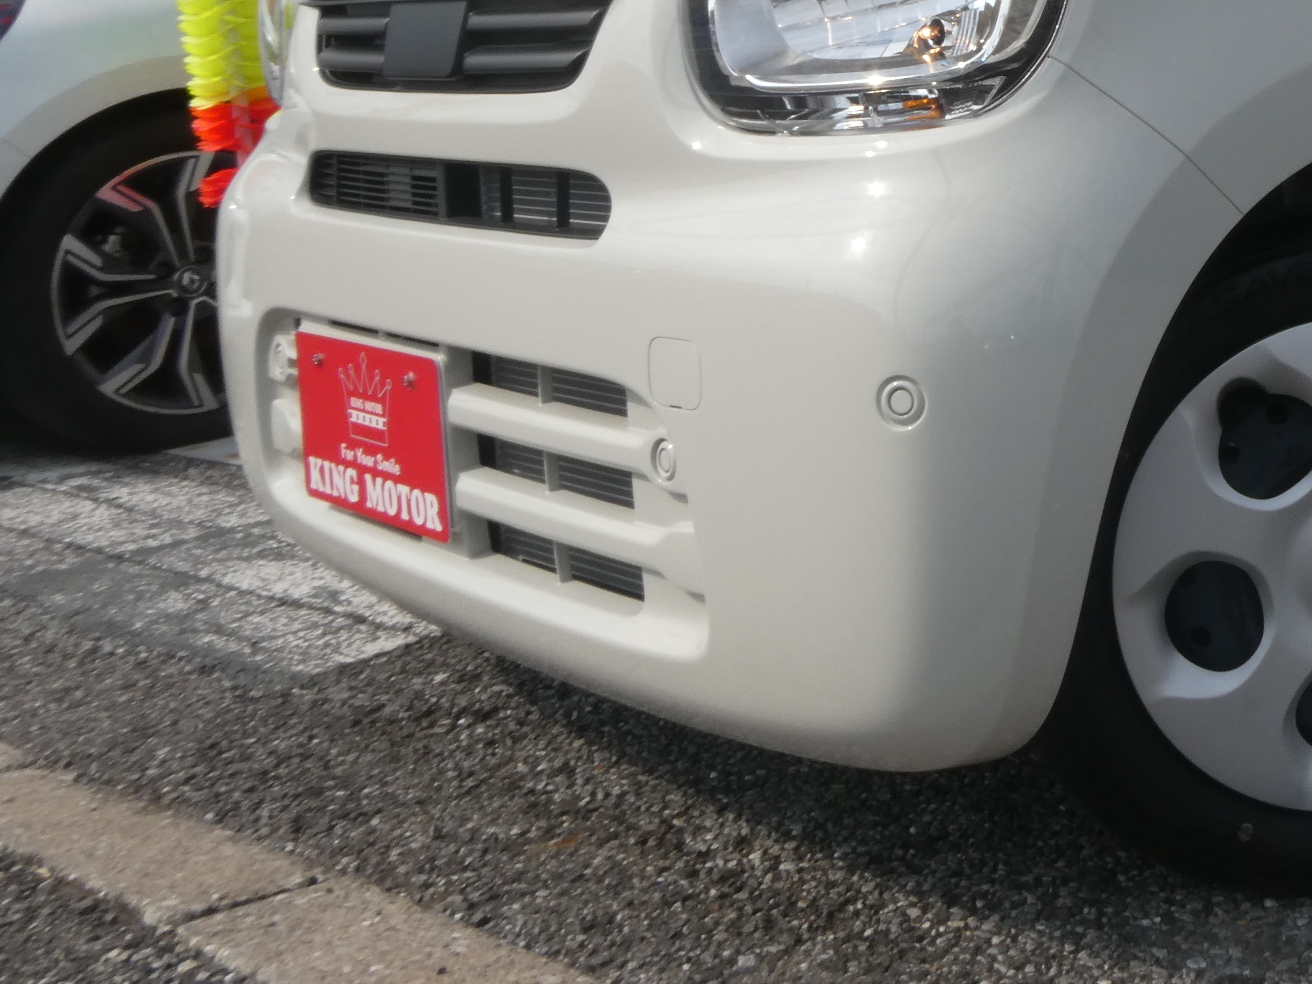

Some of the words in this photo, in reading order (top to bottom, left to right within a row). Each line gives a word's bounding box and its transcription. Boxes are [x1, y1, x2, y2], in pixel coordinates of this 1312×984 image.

[355, 447, 375, 467] Your
[376, 453, 400, 475] Smile
[308, 456, 359, 502] KING
[364, 474, 443, 532] MOTOR
